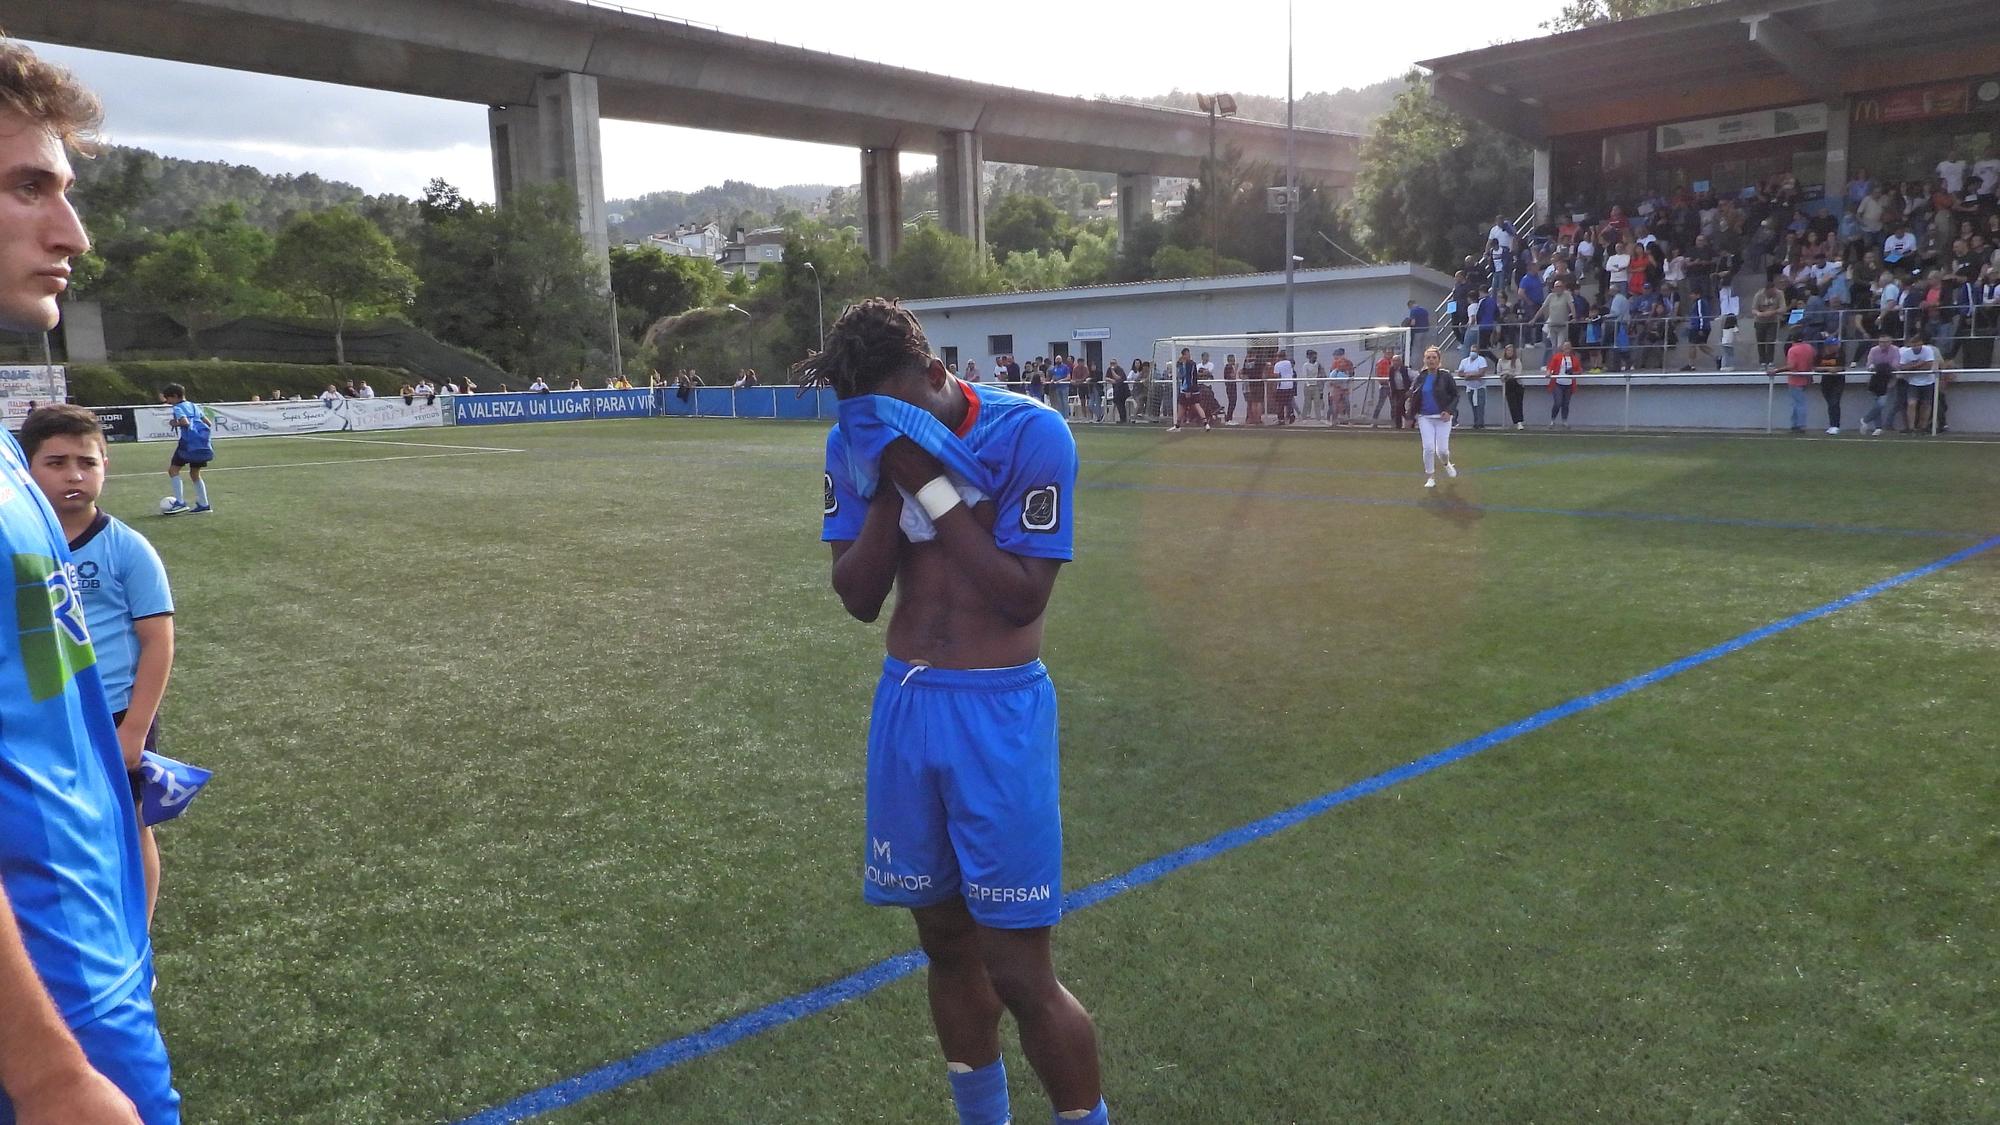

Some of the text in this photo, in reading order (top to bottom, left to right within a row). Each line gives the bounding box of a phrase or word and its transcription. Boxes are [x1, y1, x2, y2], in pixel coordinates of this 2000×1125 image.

[458, 404, 467, 419] A
[468, 400, 525, 418] VALENZA
[529, 399, 547, 415] UN
[550, 397, 591, 414] LUGAR
[596, 395, 627, 412] PARA
[214, 416, 270, 432] Ramos
[980, 884, 1050, 903] PERSAN
